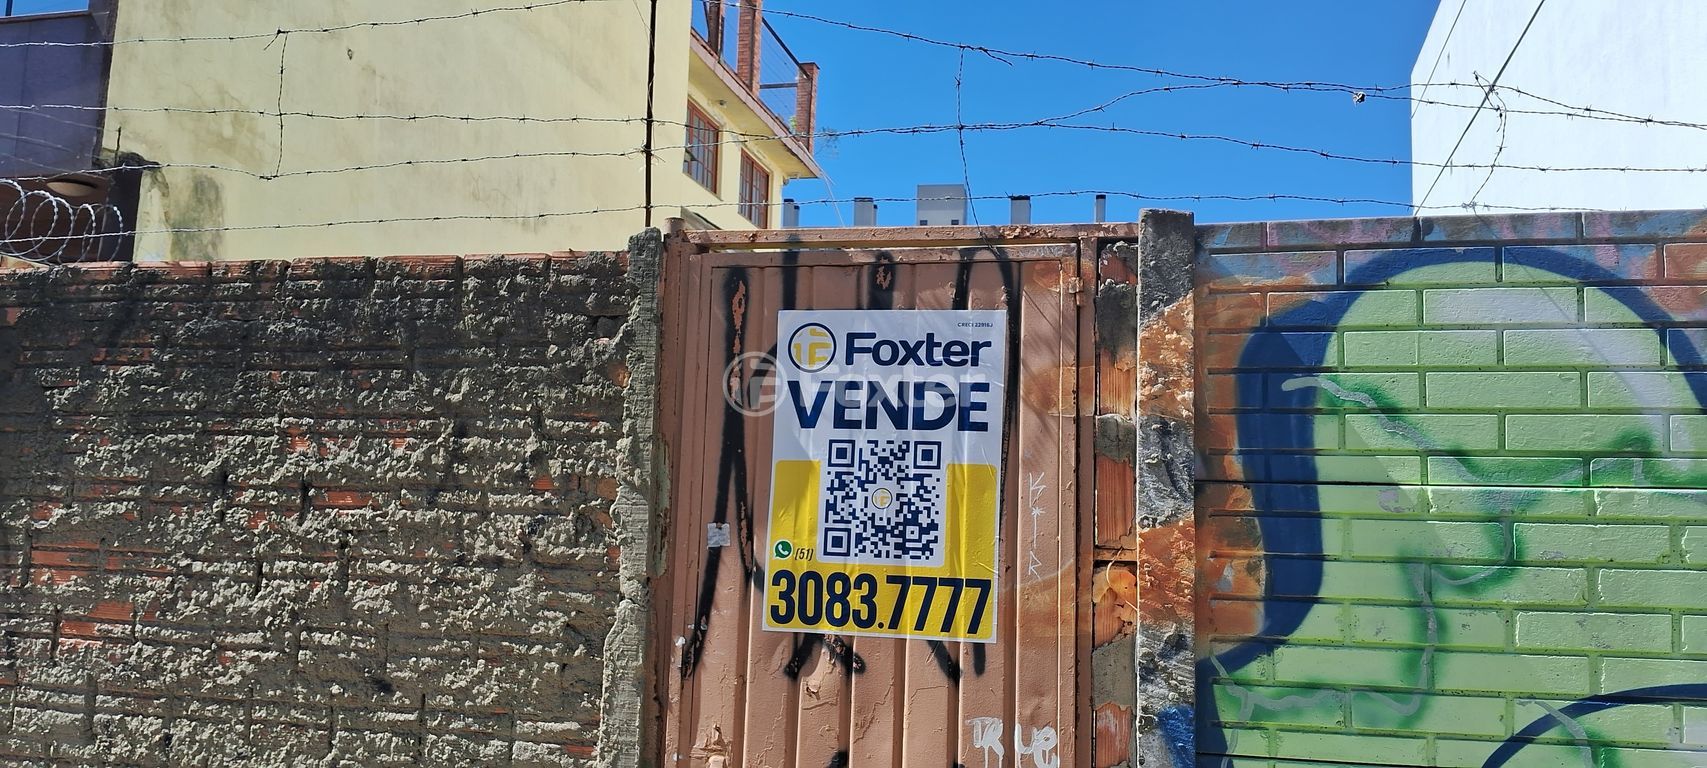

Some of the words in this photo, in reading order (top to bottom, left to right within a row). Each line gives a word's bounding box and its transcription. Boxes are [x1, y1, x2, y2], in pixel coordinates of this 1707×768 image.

[845, 332, 992, 367] Foxter
[787, 380, 989, 432] VENDE
[794, 547, 814, 562] (51)
[769, 569, 992, 635] 3083.7777
